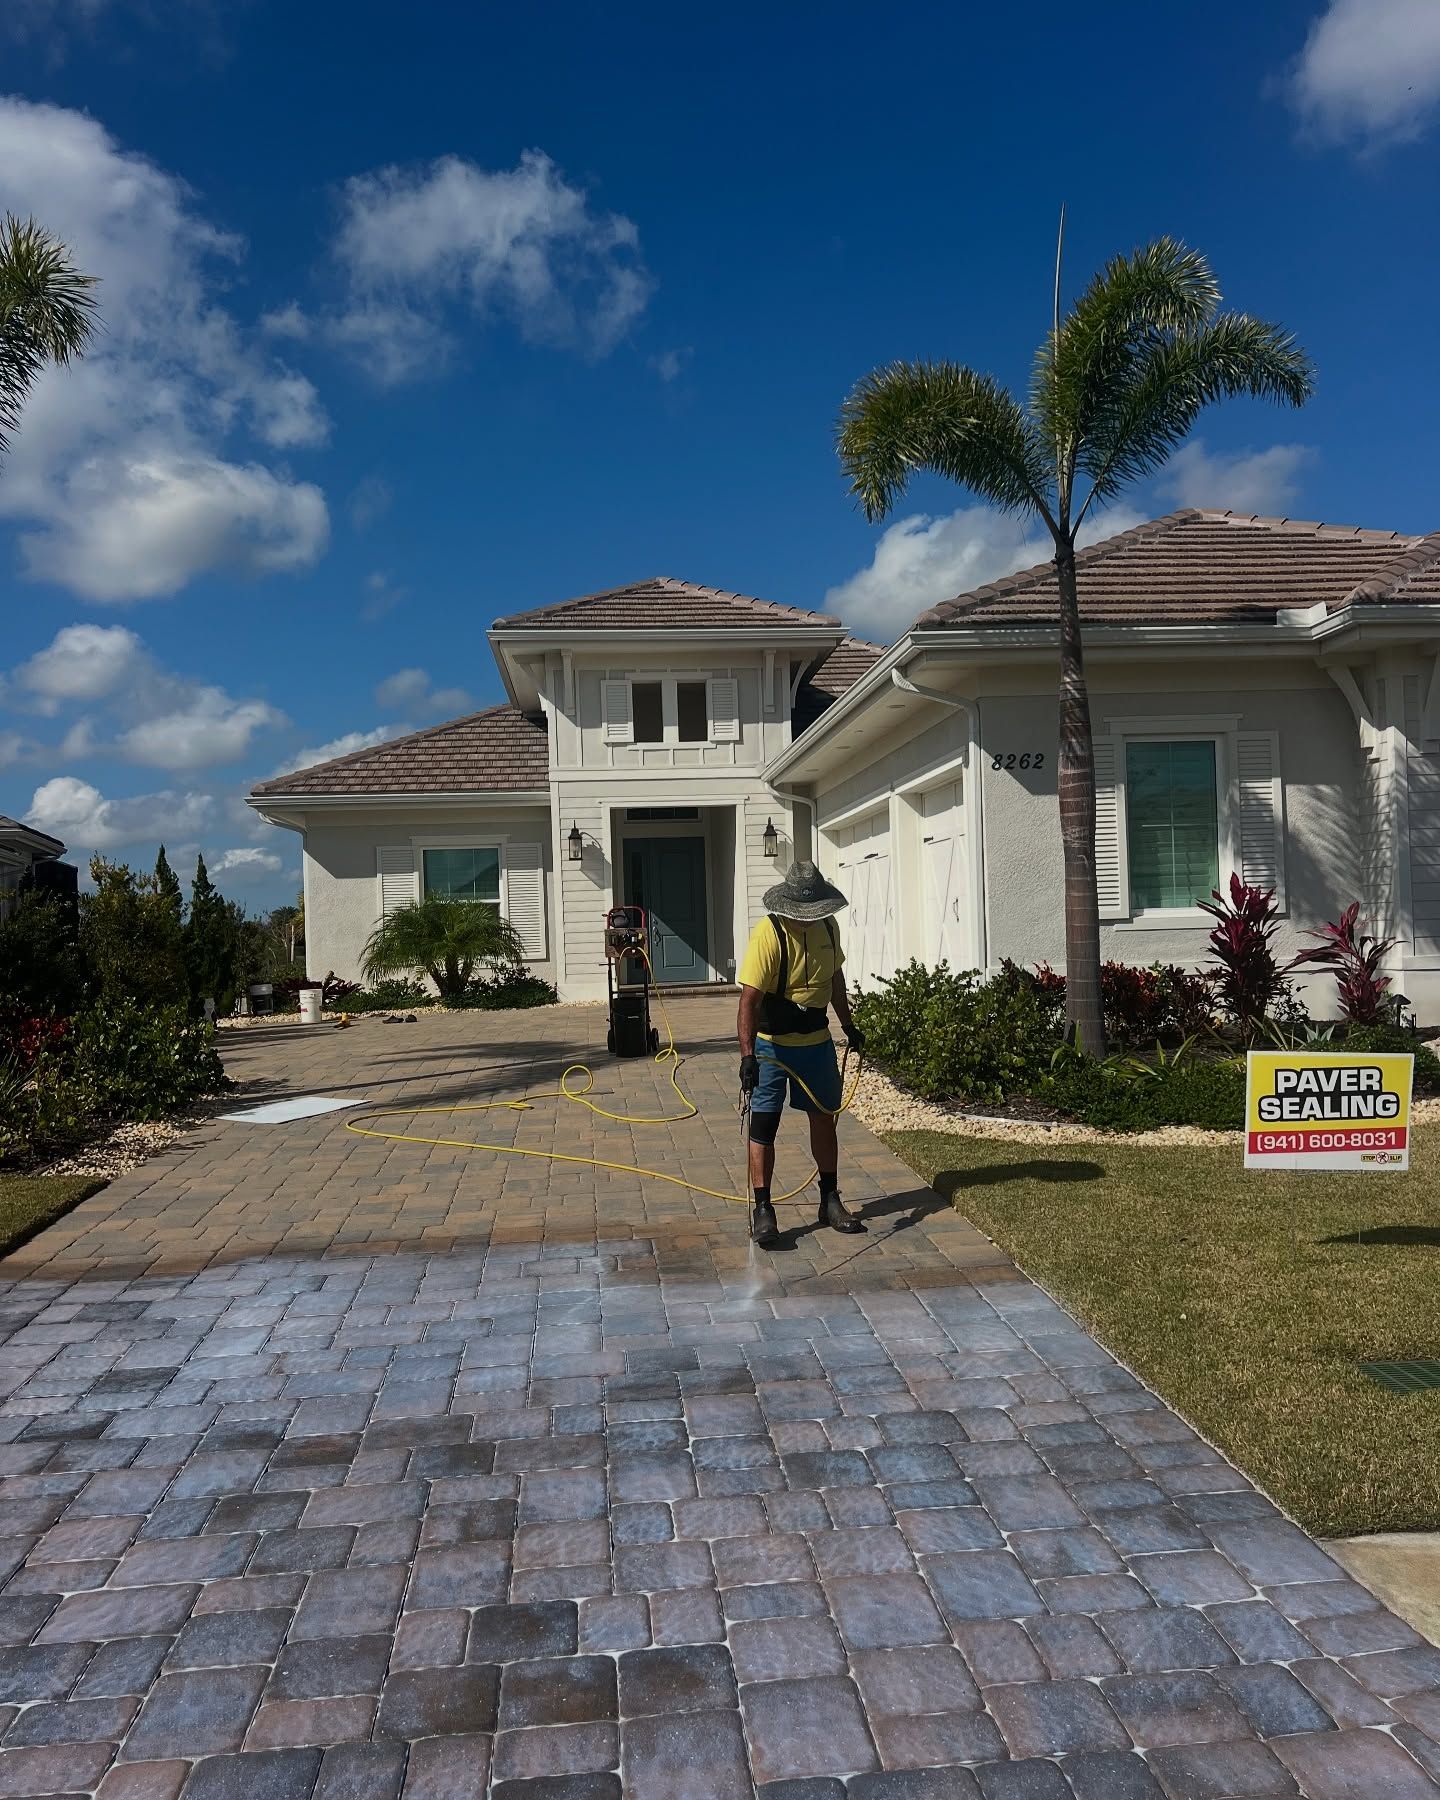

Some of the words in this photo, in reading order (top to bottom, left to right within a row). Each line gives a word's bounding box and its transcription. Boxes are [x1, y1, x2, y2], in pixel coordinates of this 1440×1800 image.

[991, 752, 1045, 772] 8262
[1276, 1067, 1381, 1094] PAVER
[1260, 1094, 1398, 1120] SEALING
[1257, 1134, 1304, 1152] (941)
[1309, 1131, 1396, 1148] 600-8031
